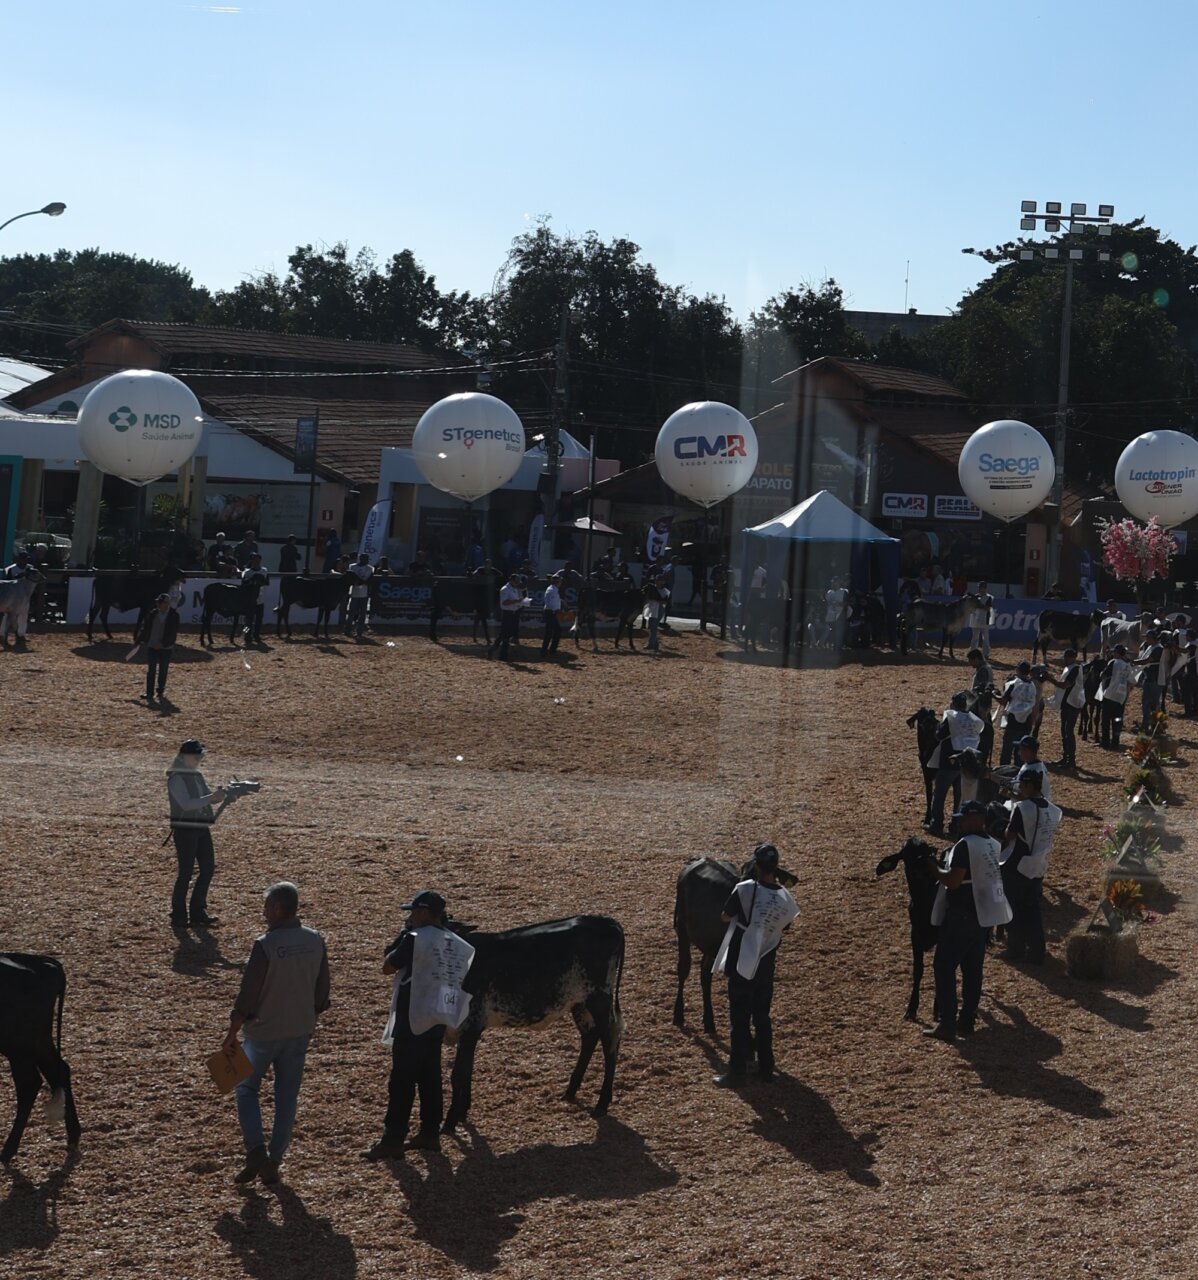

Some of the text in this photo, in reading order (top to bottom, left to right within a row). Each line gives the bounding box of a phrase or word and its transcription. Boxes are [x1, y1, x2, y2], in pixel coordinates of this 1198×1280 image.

[144, 414, 181, 429] MSD
[170, 432, 195, 441] Animal
[442, 427, 521, 449] STgenetics
[674, 434, 747, 460] CMR
[978, 453, 1040, 475] Saega
[1129, 466, 1196, 482] Lactotropin
[885, 496, 925, 510] CMR
[378, 582, 433, 602] Saega
[444, 992, 456, 1005] 04
